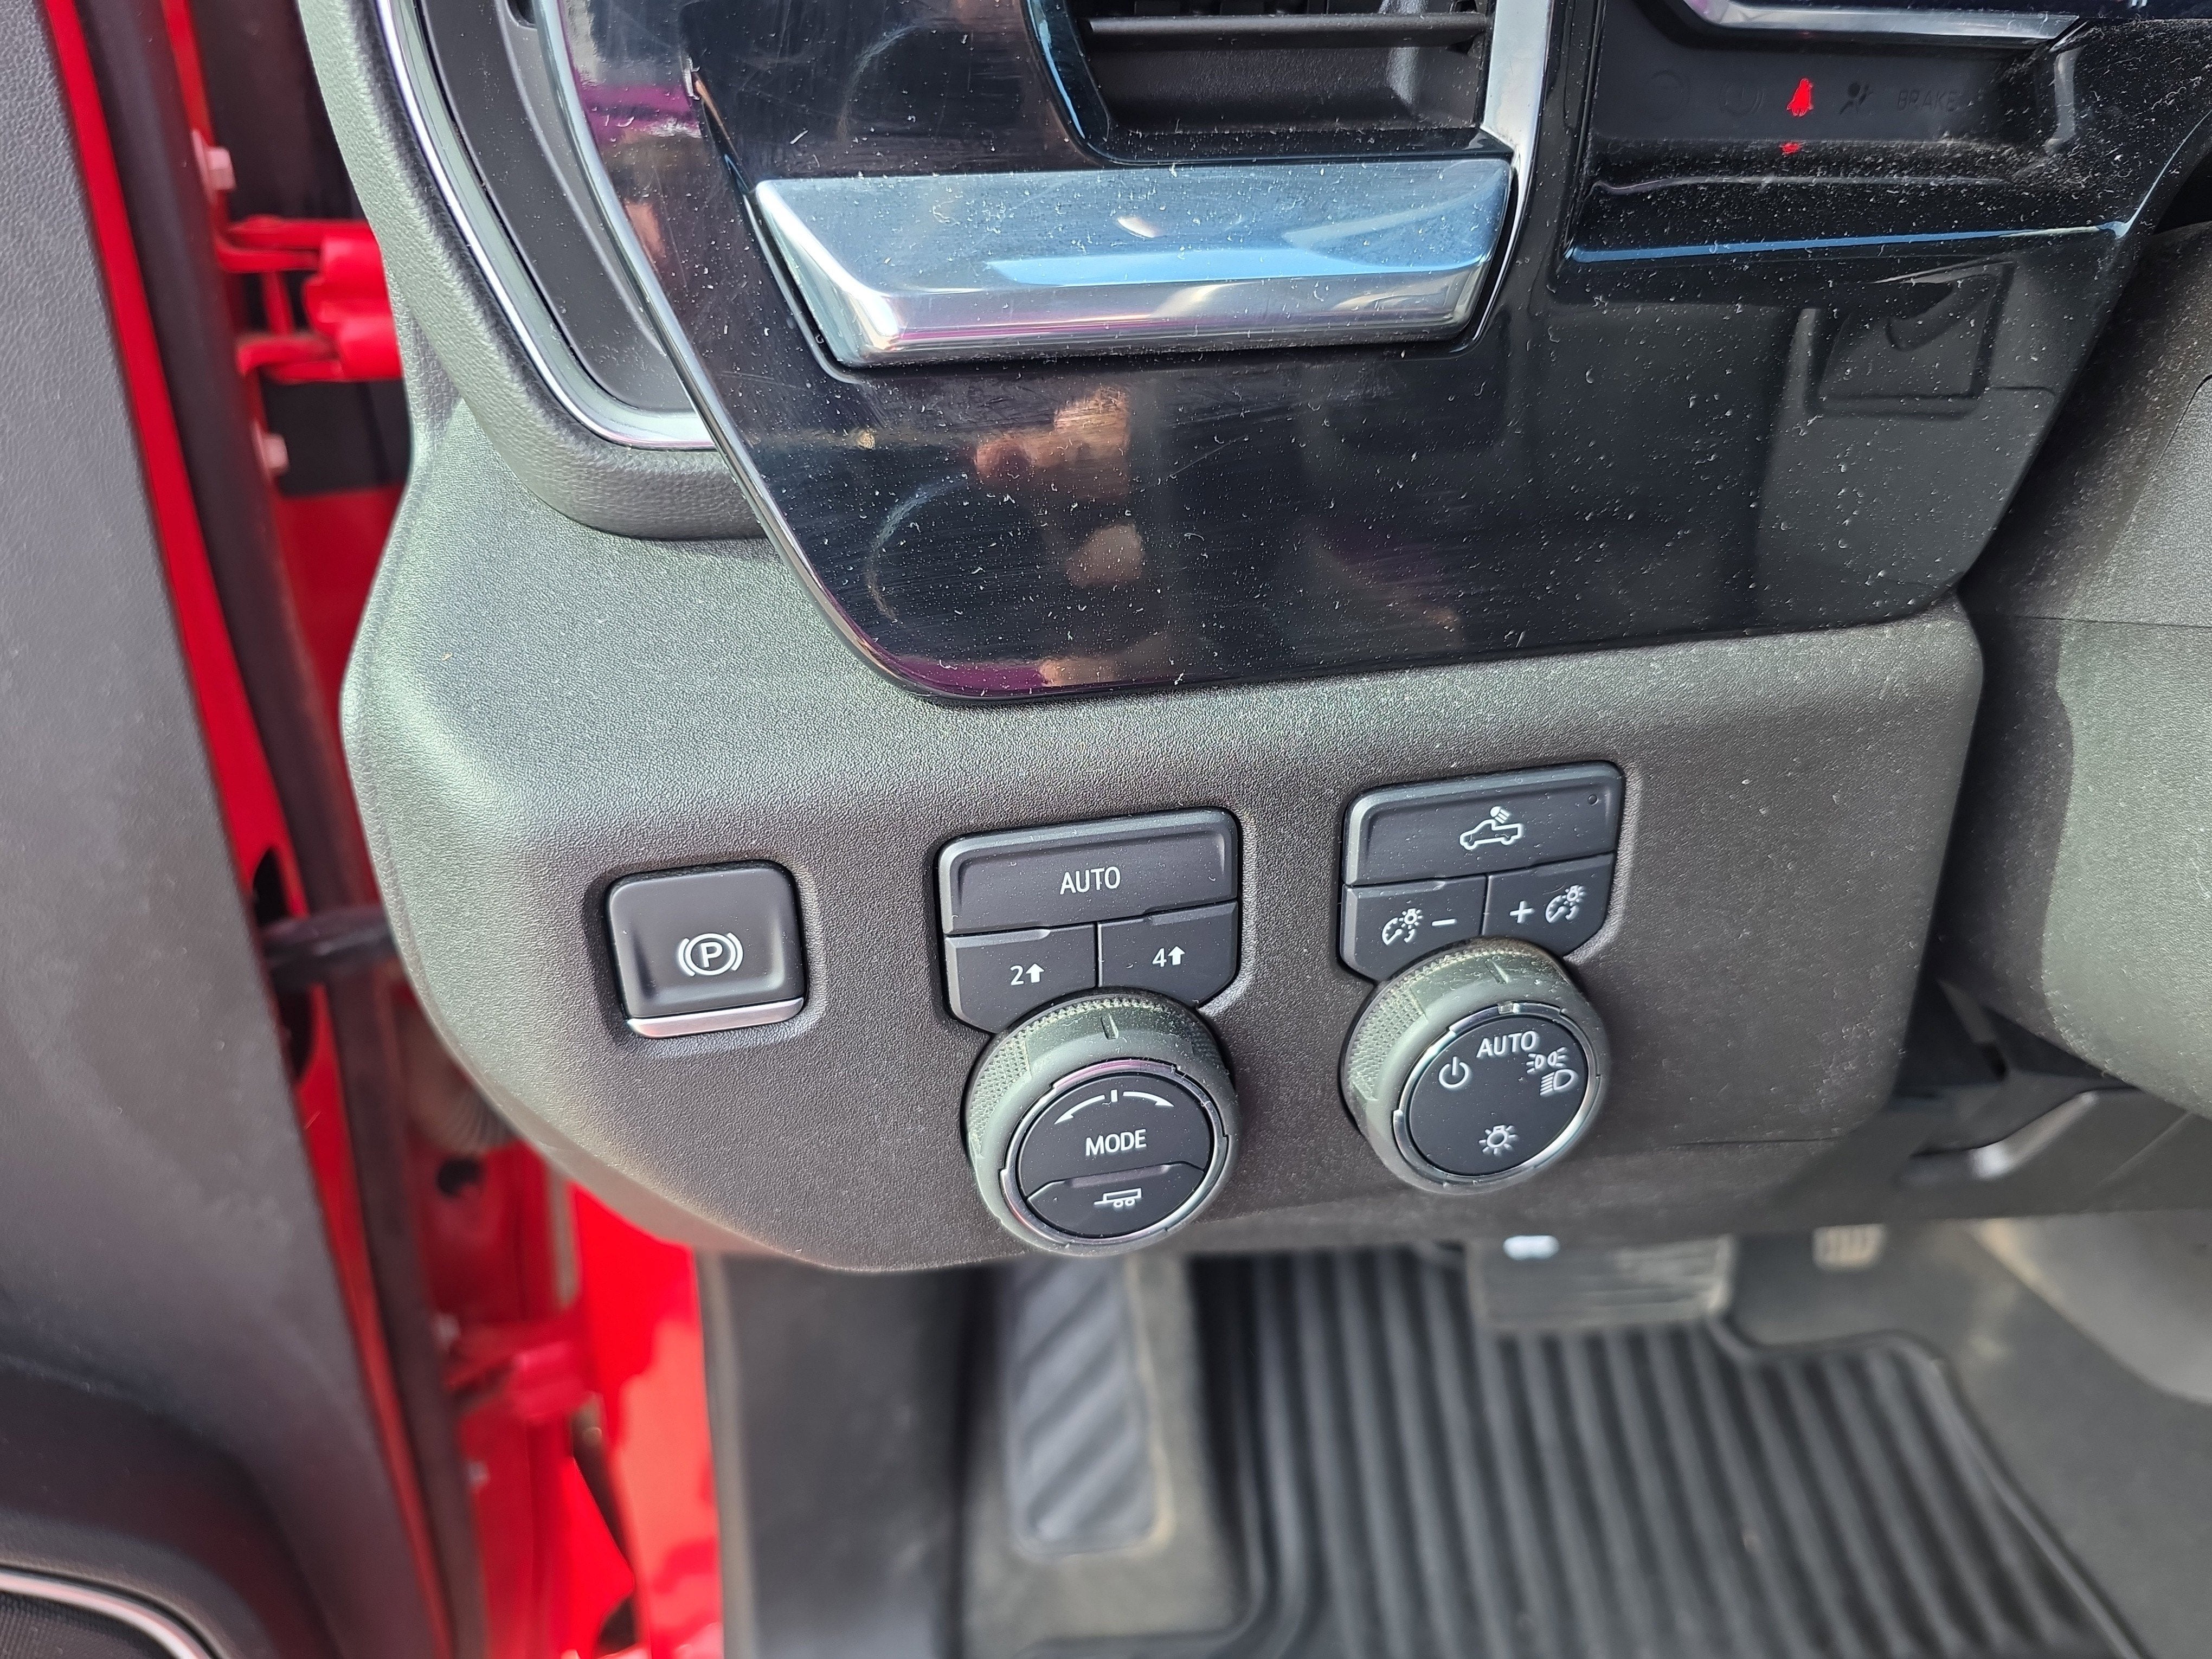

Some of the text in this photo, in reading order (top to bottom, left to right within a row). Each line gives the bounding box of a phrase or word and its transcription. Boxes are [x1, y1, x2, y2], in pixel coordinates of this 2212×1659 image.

[1898, 88, 1959, 112] BRAKE
[1060, 866, 1121, 895] AUTO
[700, 941, 723, 968] P
[1476, 1030, 1537, 1058] AUTO
[1085, 1128, 1147, 1156] MODE
